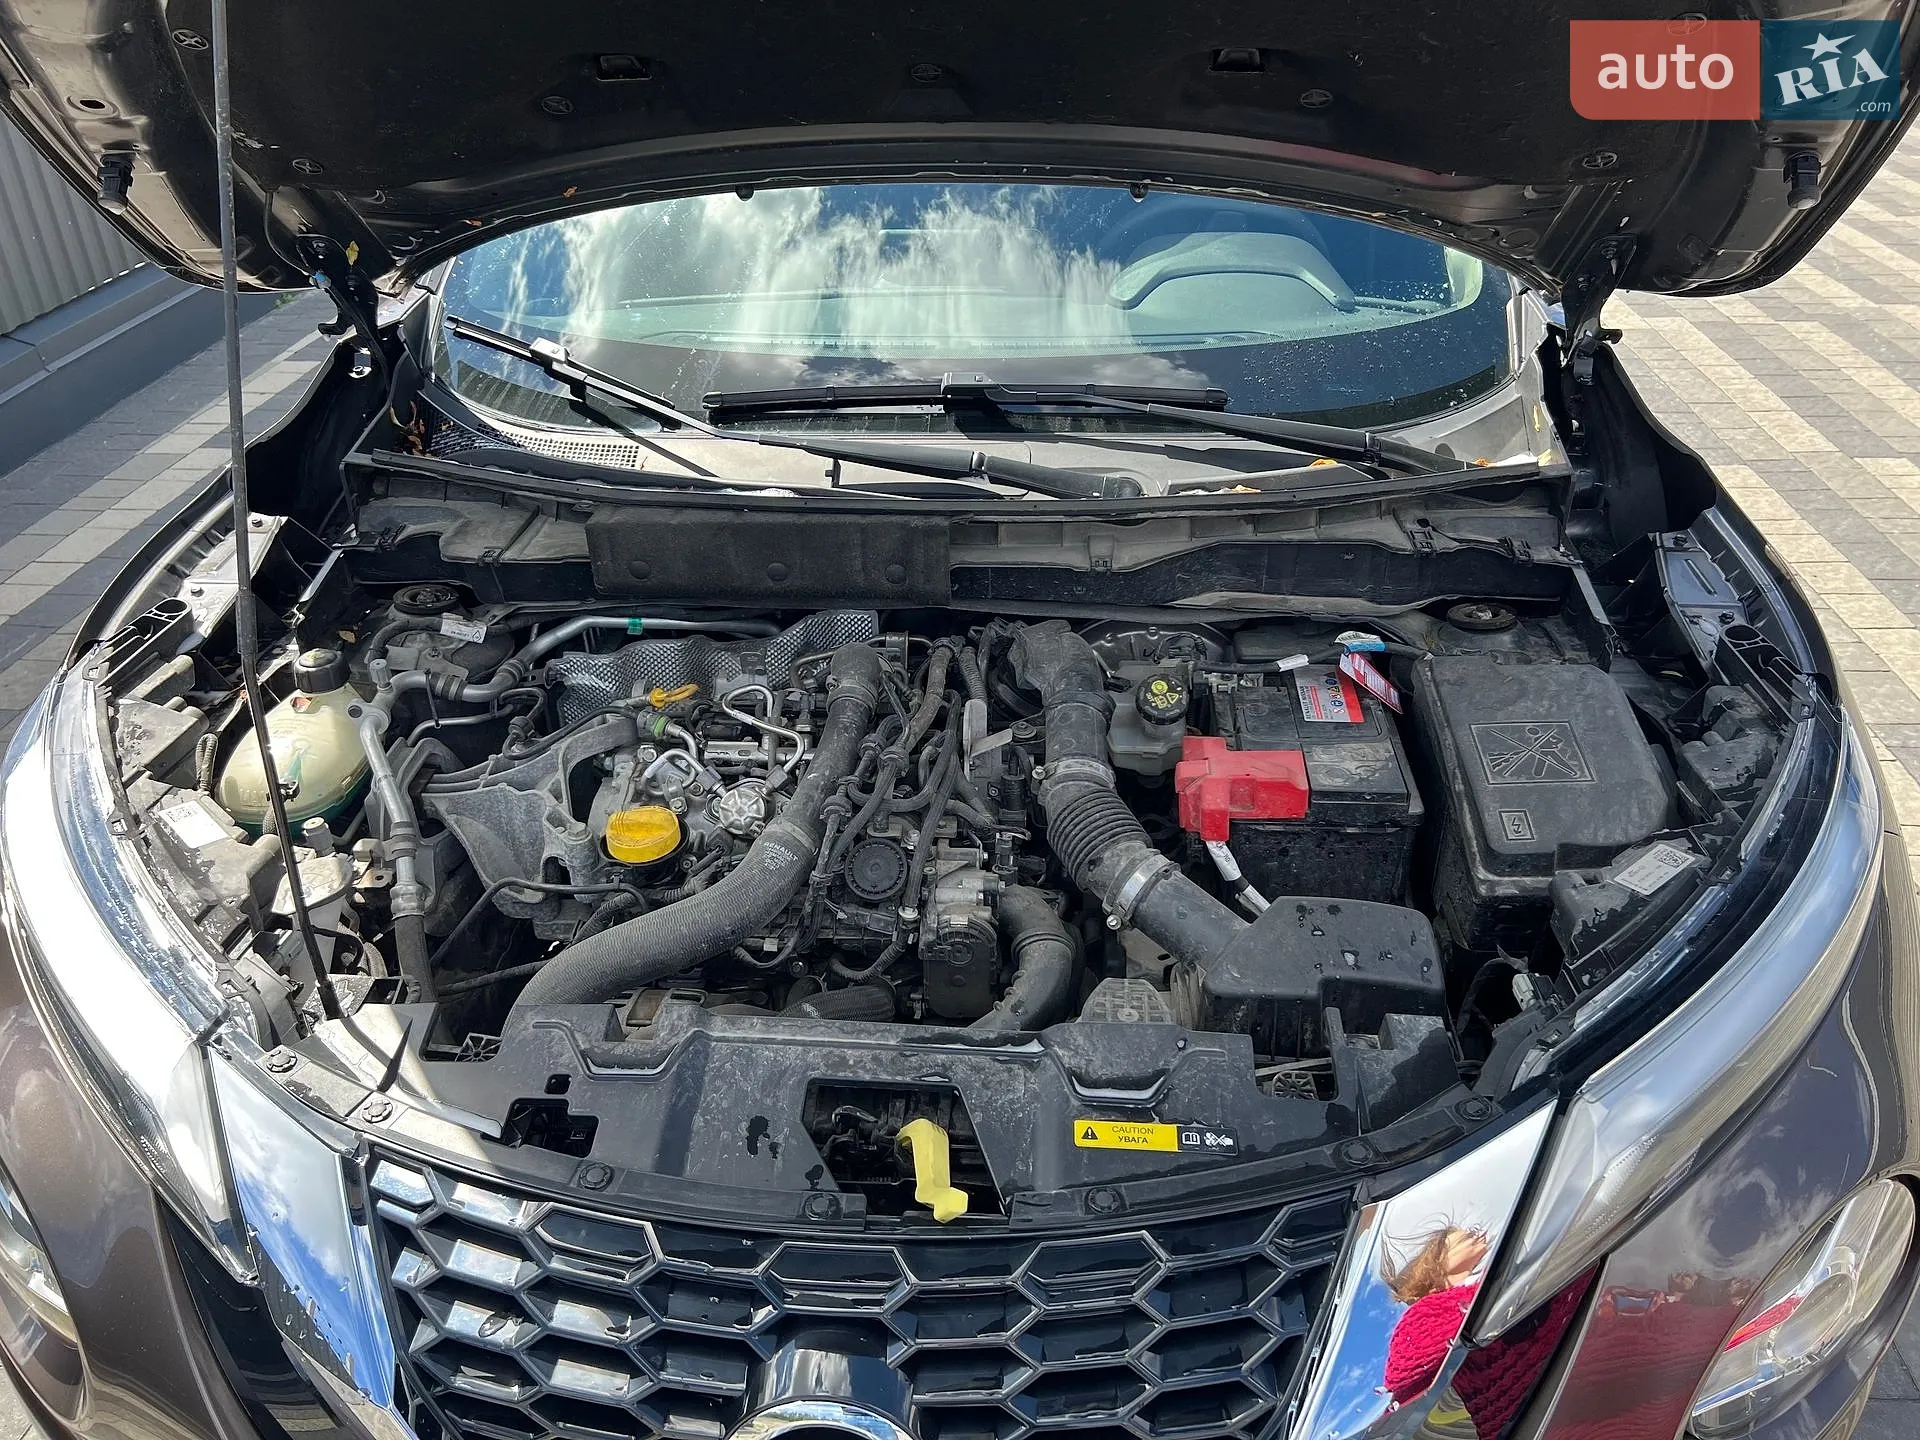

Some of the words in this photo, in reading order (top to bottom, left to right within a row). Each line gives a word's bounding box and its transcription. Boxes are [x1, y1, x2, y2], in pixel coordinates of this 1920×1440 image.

[763, 841, 799, 861] RENAULT
[1111, 1125, 1154, 1134] CAUTION
[1118, 1135, 1149, 1144] УВАГА
